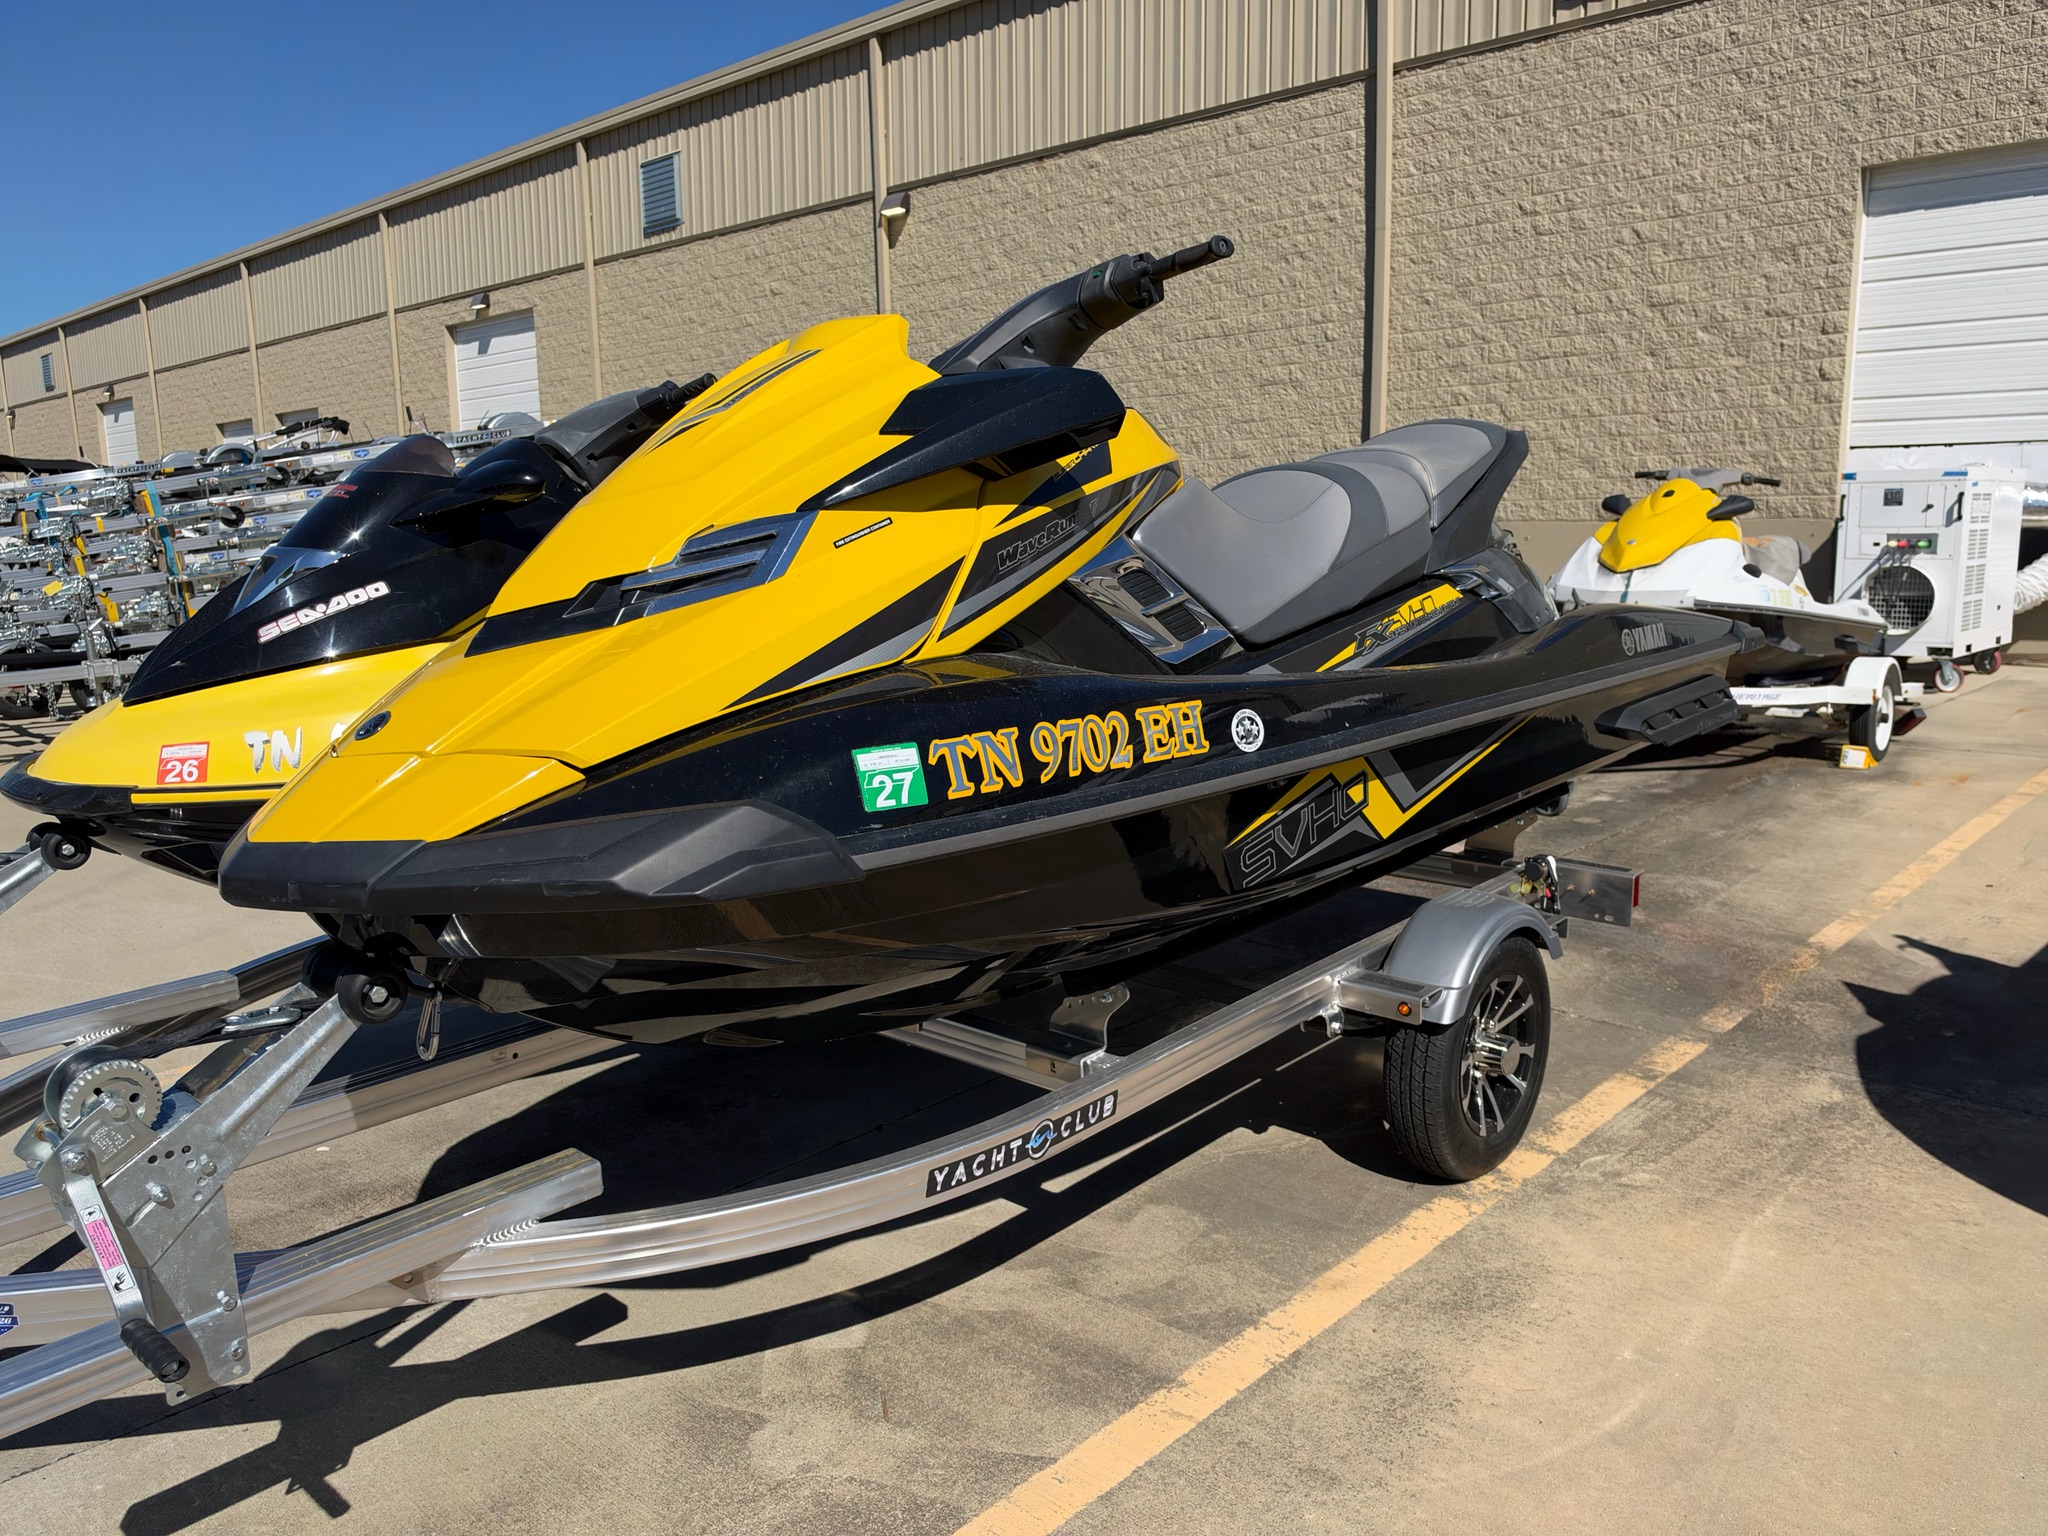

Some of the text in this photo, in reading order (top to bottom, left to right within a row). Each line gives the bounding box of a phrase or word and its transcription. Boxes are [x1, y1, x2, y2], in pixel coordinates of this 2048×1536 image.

[457, 430, 511, 443] YACHT CLUB
[997, 496, 1100, 572] WaveRun
[1632, 622, 1673, 653] YAMAH
[164, 759, 199, 783] 26
[243, 725, 303, 774] TN
[928, 700, 1210, 800] TN 9702 EH
[872, 771, 914, 808] 27
[1240, 768, 1369, 889] SVHO
[934, 1094, 1116, 1192] YACHT CLUB
